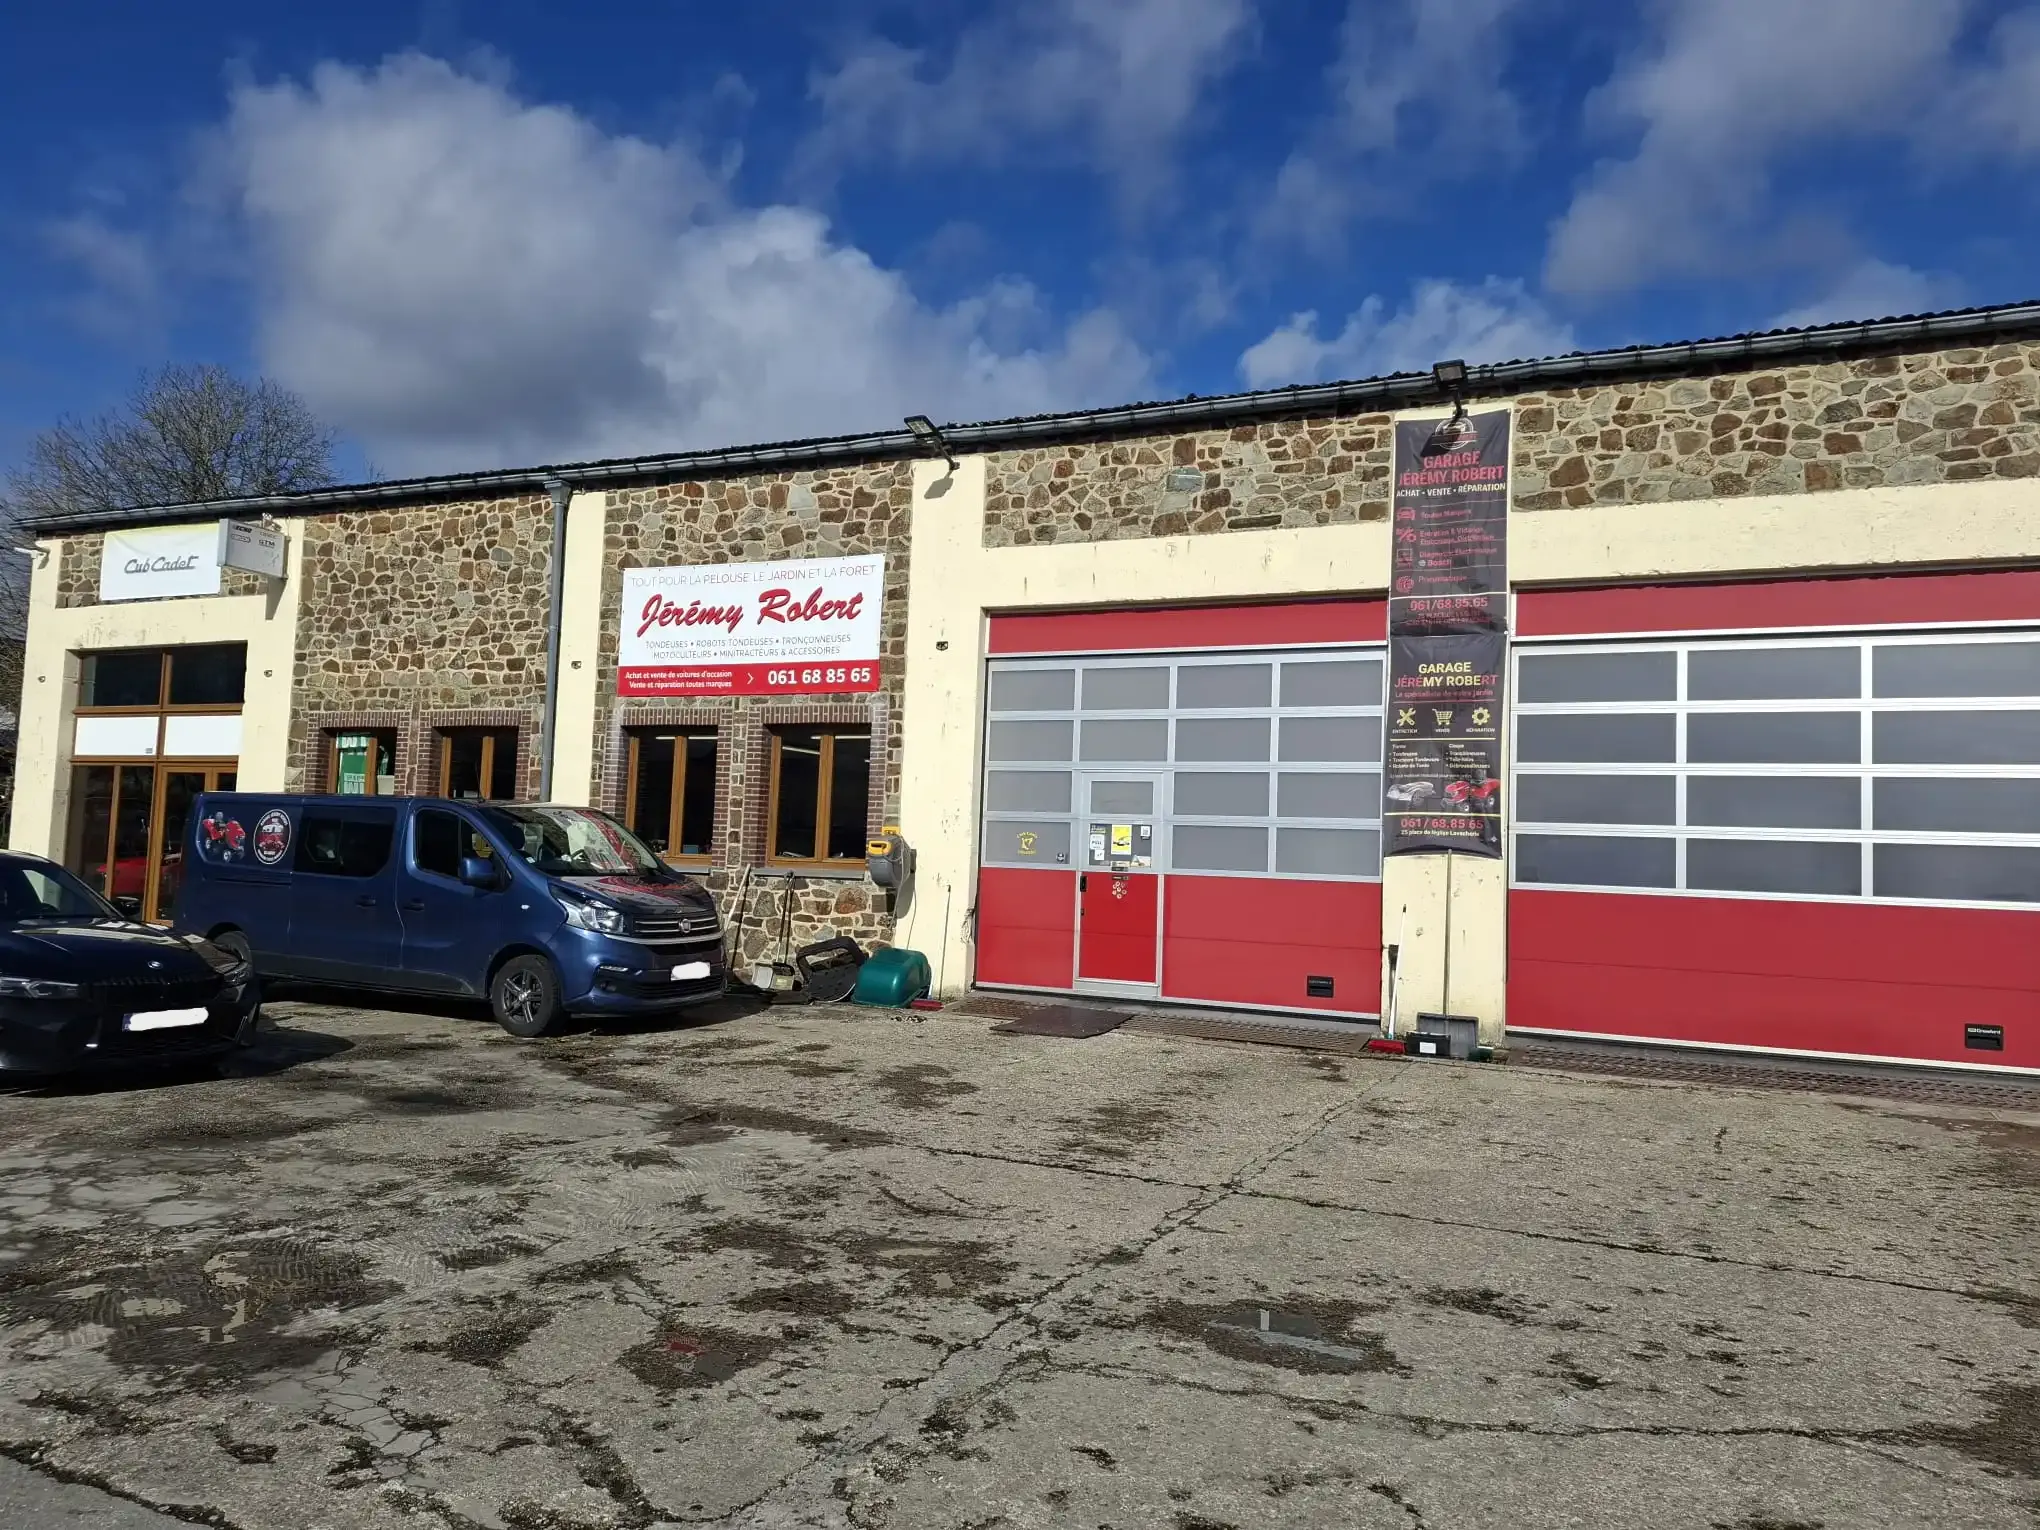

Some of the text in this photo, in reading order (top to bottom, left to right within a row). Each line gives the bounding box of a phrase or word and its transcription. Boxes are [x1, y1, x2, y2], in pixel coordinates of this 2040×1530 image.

[1423, 451, 1480, 469] GARAGE
[1451, 465, 1504, 483] ROBERT
[1396, 482, 1506, 497] ACHAT VENTE RÉPARATION
[124, 556, 199, 574] Cub Cadet
[632, 565, 876, 587] TOUT POUR LA PELOUSE LE JARDIN ET LA FORET
[636, 586, 864, 637] Jérémy Robert
[646, 634, 851, 649] TONDEUSES ROBOTS TONDEUSES TRONÇONNEUSES
[653, 650, 712, 659] MOTOCULTEURS
[719, 648, 779, 658] MINITRACTEURS
[788, 646, 841, 656] ACCESSOIRES
[625, 671, 642, 679] Achat
[1418, 662, 1472, 674] GARAGE
[768, 667, 871, 685] 061 68 85 65
[1394, 674, 1498, 688] JÉRÉMY ROBERT
[705, 681, 732, 689] marques
